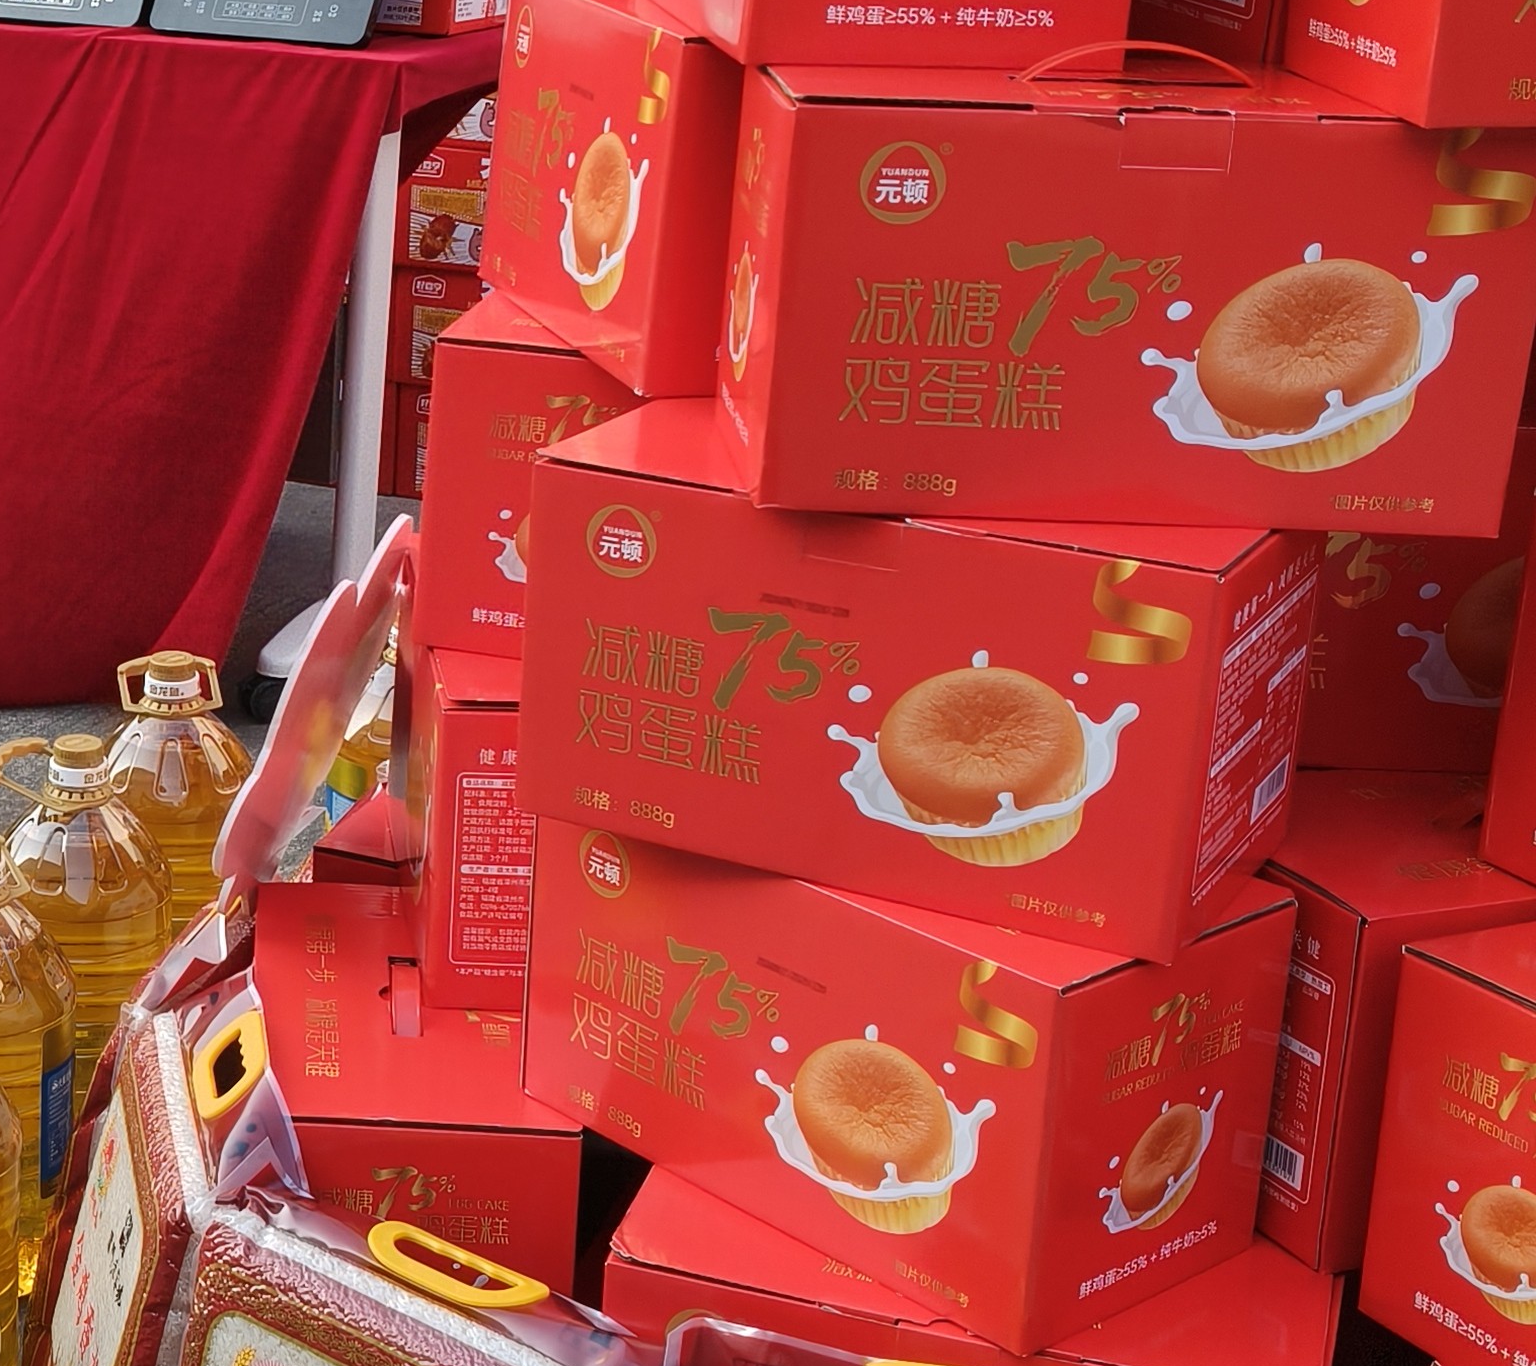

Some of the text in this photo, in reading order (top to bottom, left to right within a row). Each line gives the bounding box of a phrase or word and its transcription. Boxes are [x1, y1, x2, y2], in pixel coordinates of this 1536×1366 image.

[825, 4, 1055, 28] 鲜鸡蛋≥55% 纯牛奶≥5%
[875, 178, 930, 205] 元顿
[880, 167, 930, 177] YUANDUN
[850, 235, 1183, 358] 减糖 75%
[838, 355, 1066, 431] 鸡蛋糕
[490, 412, 547, 444] 减糖
[598, 537, 644, 563] 元顿
[581, 606, 861, 710] 减糖 75%
[149, 684, 179, 697] 金龙鱼
[575, 688, 762, 785] 鸡蛋糕
[588, 856, 621, 886] 元顿
[576, 928, 665, 1020] 减糖
[666, 936, 781, 1039] 75%
[571, 992, 707, 1110] 鸡蛋糕
[1105, 989, 1210, 1081] 减糖 75%
[1443, 1054, 1500, 1111] 减糖
[372, 1166, 457, 1219] 75%
[1079, 1220, 1218, 1300] 鲜鸡蛋≥55% 纯牛奶≥5%
[1414, 1291, 1498, 1356] 鲜鸡蛋≥55%
